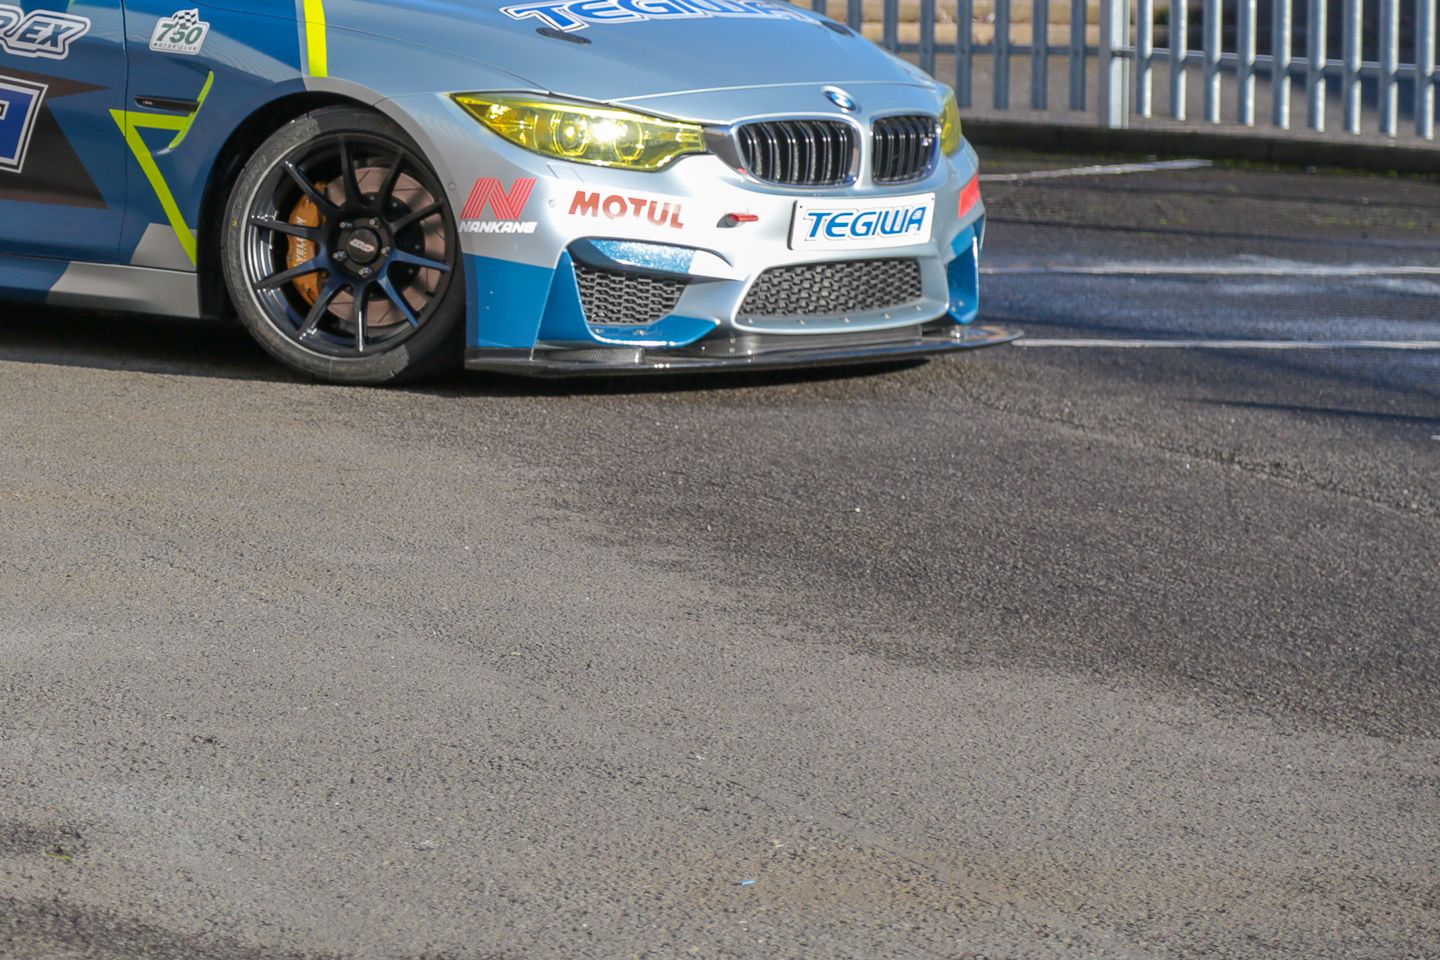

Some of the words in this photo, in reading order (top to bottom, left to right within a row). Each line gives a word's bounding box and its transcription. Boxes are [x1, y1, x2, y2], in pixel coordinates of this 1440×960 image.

[157, 23, 203, 45] 750
[568, 190, 684, 229] MOTUL
[806, 205, 928, 239] TEGIWA
[458, 221, 538, 234] NANKANG
